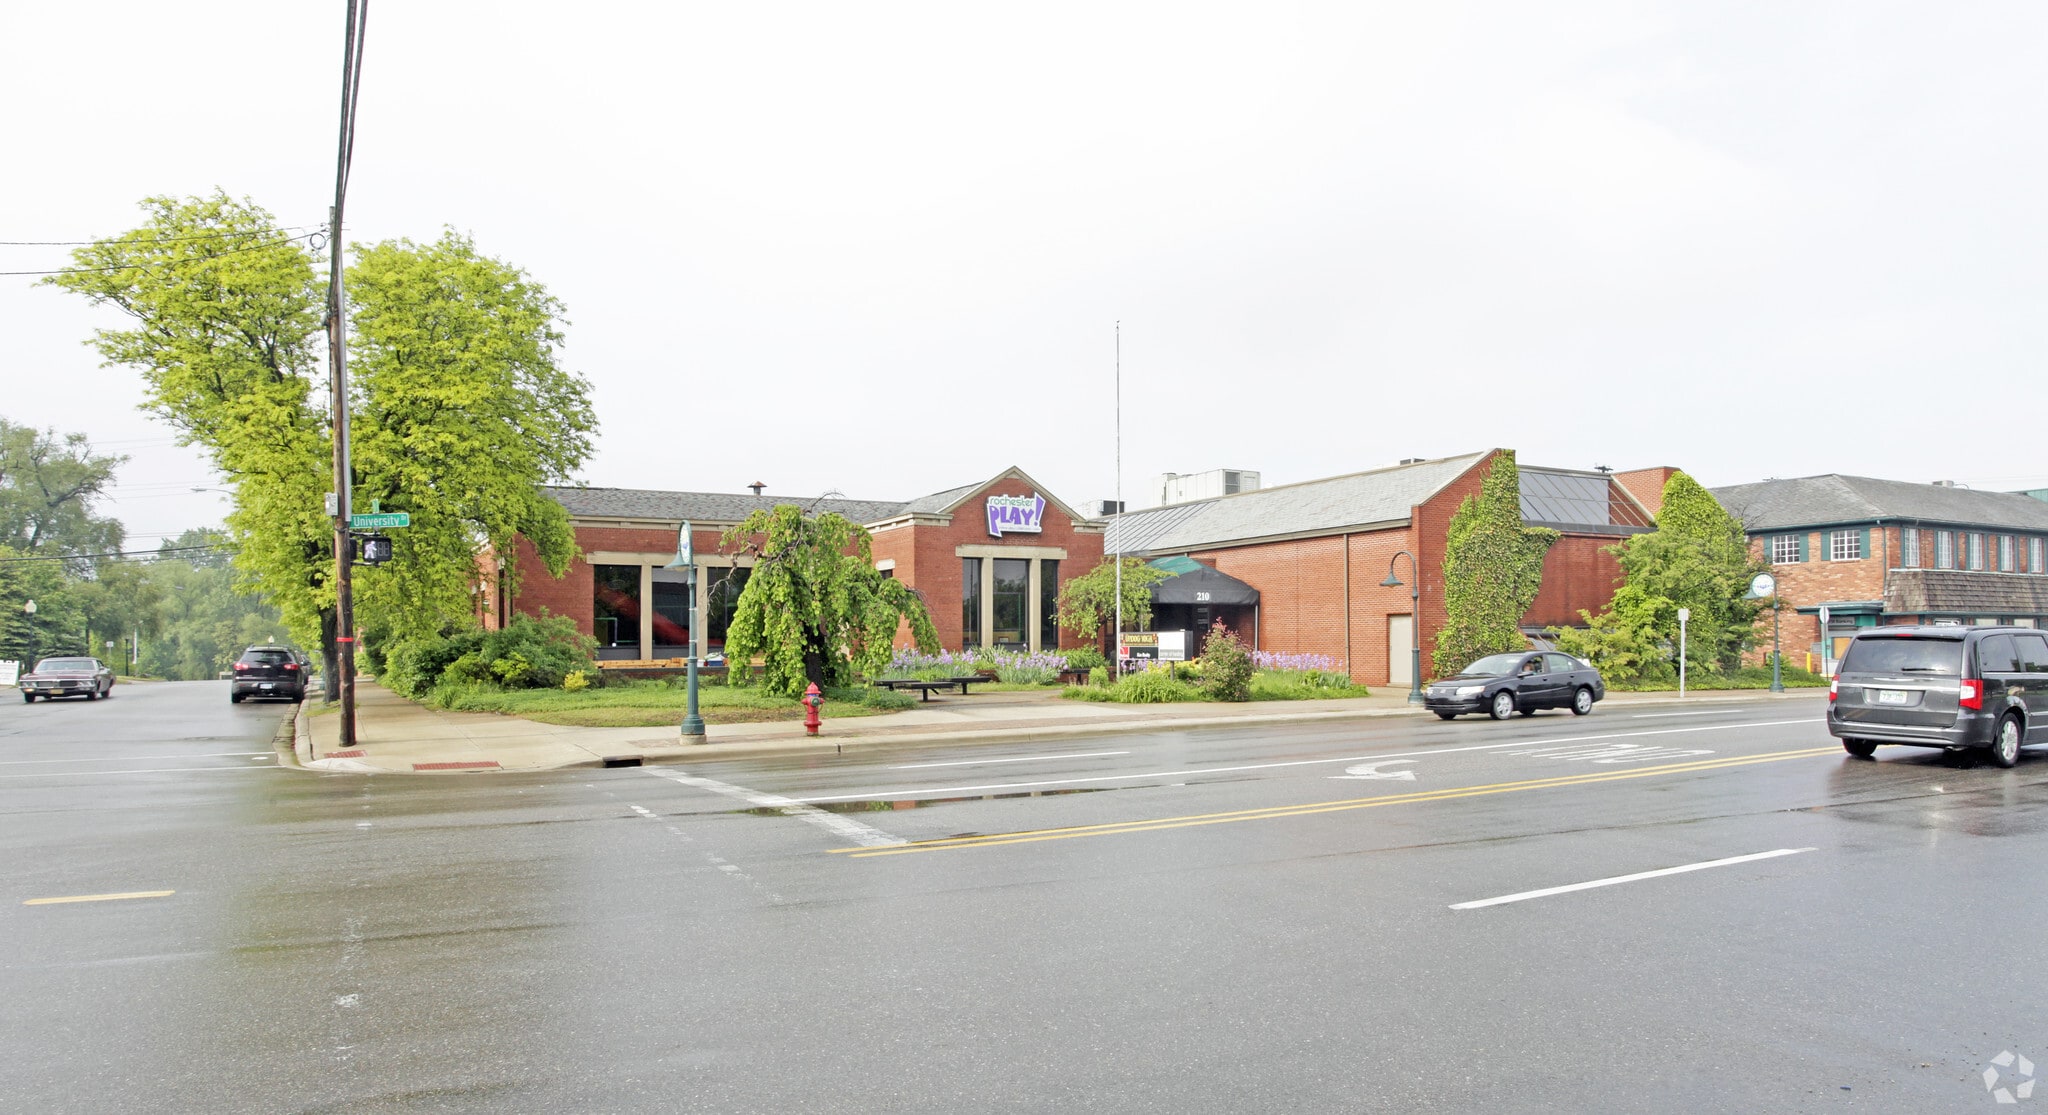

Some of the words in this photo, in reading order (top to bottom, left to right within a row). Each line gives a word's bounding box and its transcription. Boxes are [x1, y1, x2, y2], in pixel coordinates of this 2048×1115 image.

[990, 498, 1034, 507] rochester
[989, 496, 1044, 534] PLAY!
[353, 516, 400, 527] University
[1196, 592, 1210, 601] 210
[1488, 742, 1716, 764] ONLY
